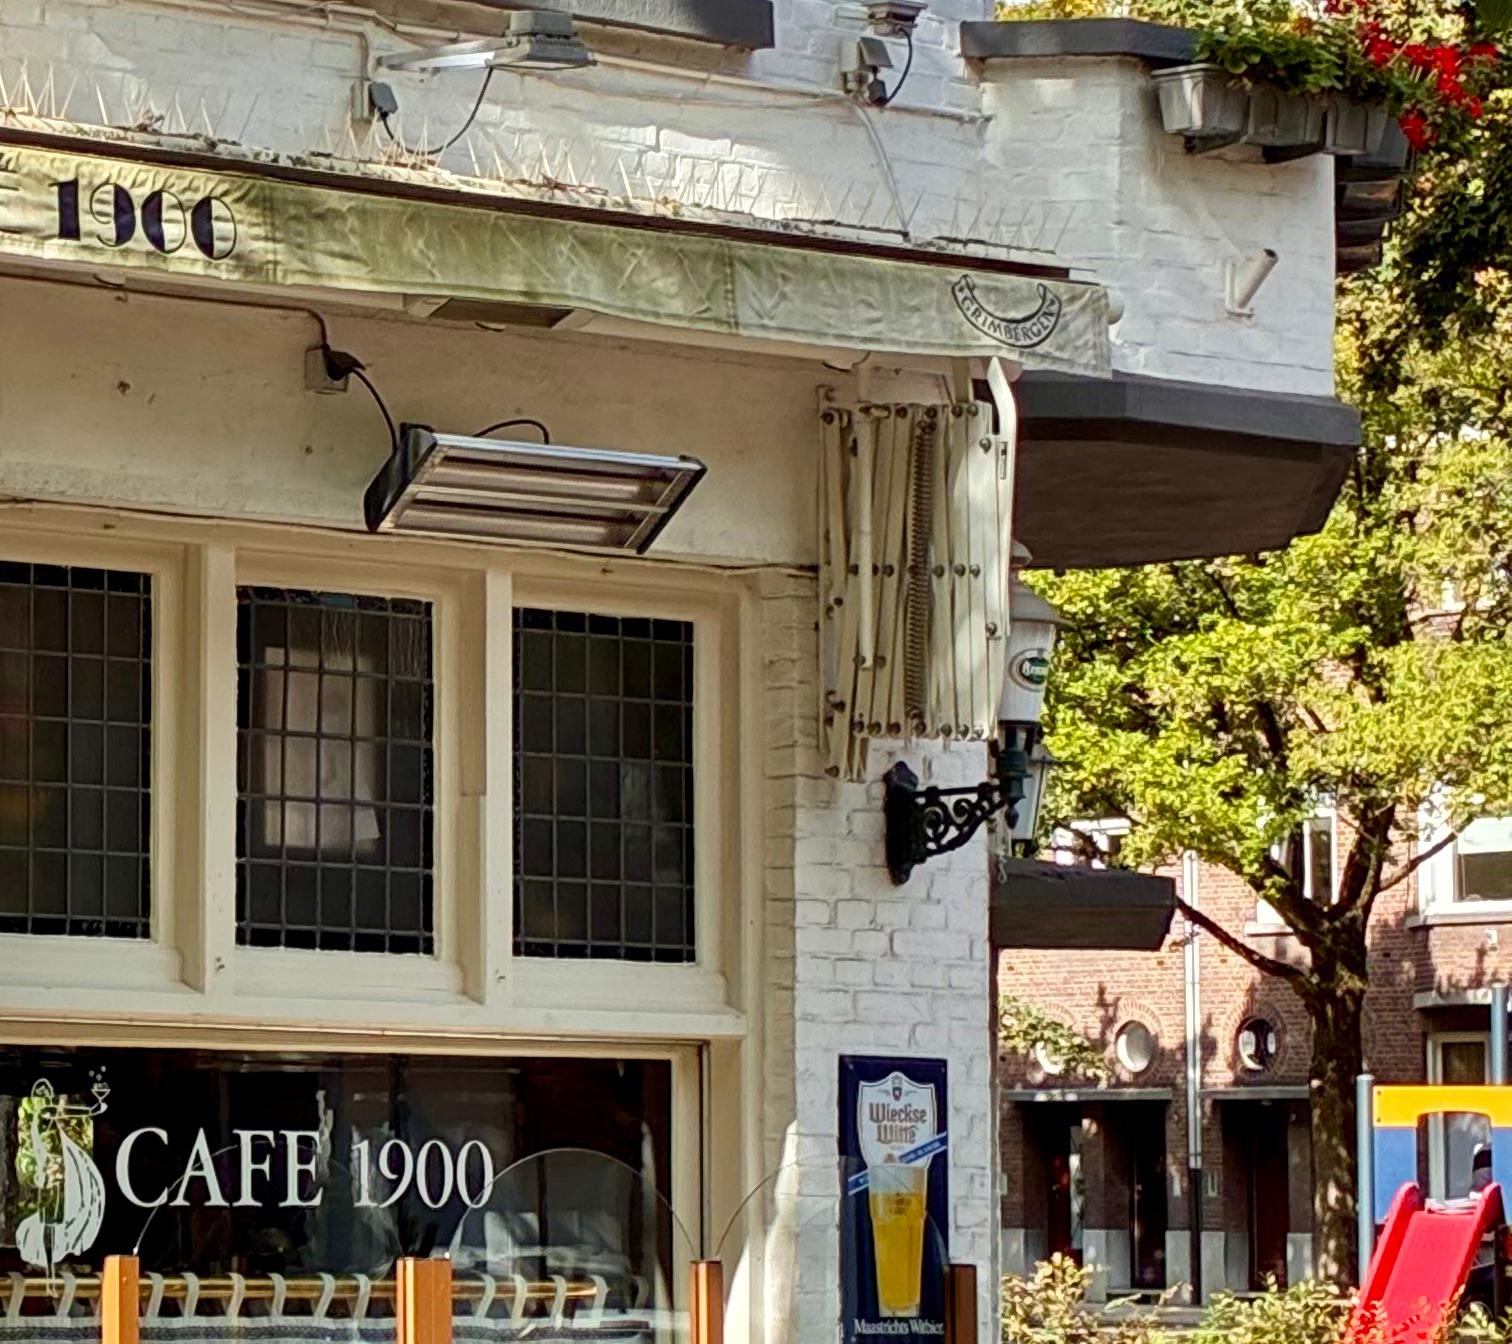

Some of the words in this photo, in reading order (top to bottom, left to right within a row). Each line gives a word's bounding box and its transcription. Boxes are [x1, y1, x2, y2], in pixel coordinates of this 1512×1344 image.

[48, 176, 238, 260] 1900
[961, 296, 1057, 343] GRIMBERGEN
[869, 1102, 927, 1123] Wieckse
[115, 1127, 324, 1208] CAFE
[351, 1139, 494, 1209] 1900
